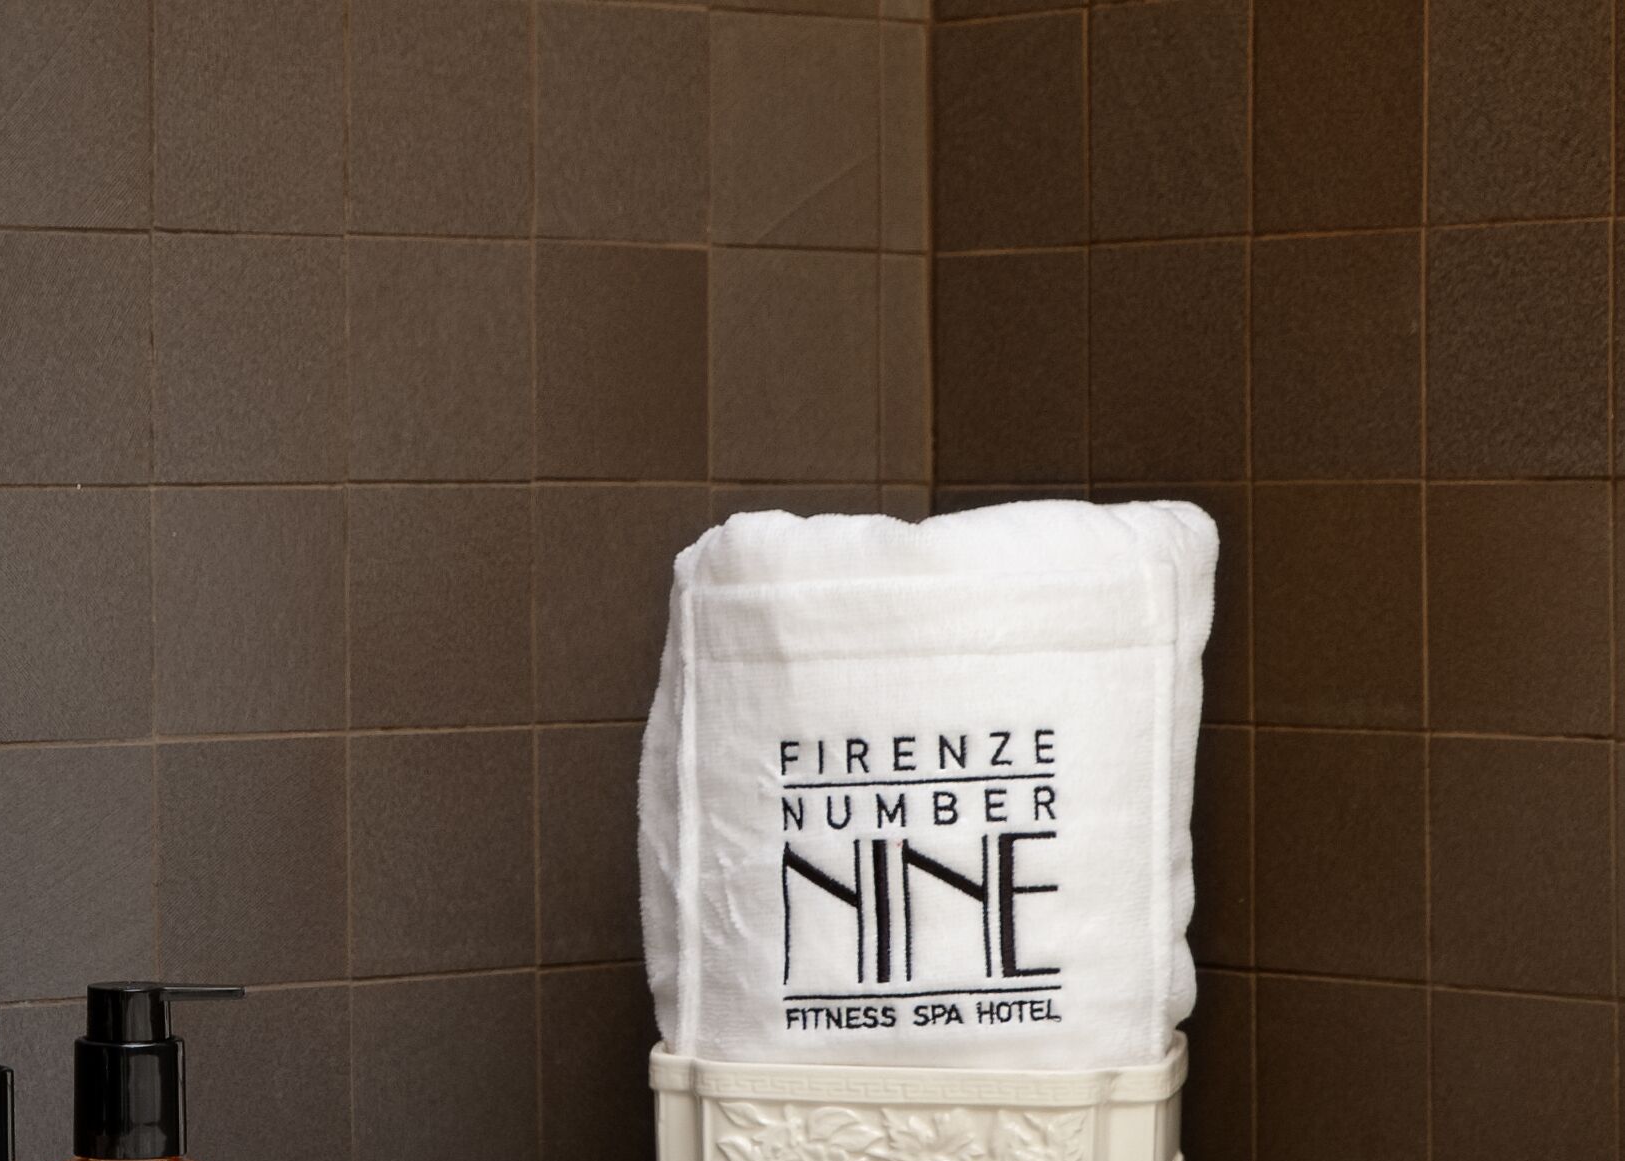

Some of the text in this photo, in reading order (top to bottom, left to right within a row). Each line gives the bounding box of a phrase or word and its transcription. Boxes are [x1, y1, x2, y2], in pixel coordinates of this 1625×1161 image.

[780, 728, 1056, 776] FIRENZE
[782, 785, 1057, 831] NUMBER
[782, 830, 1062, 986] NINE
[785, 1000, 1062, 1031] FITNESS SPA HOTEL
